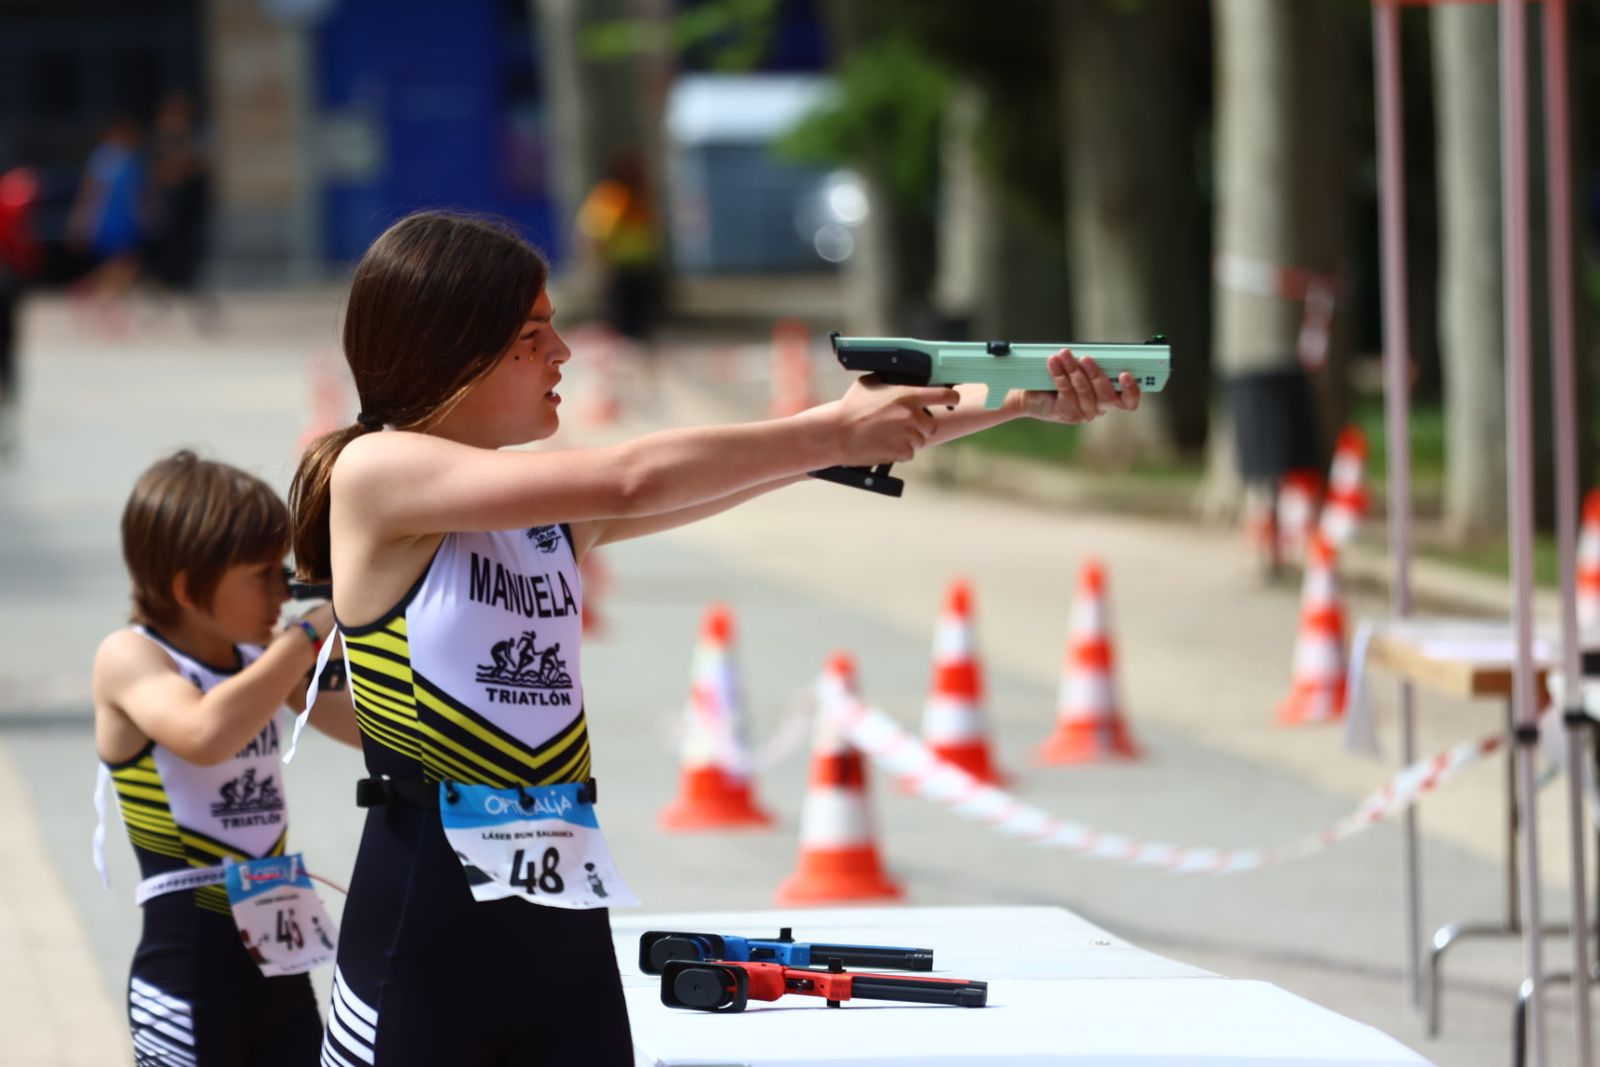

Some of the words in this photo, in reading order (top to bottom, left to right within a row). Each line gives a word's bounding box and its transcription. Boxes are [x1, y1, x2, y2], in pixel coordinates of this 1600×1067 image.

[469, 552, 578, 619] MANUELA
[485, 687, 572, 706] TRIATLÓN
[235, 719, 279, 758] AYA
[509, 846, 565, 895] 48
